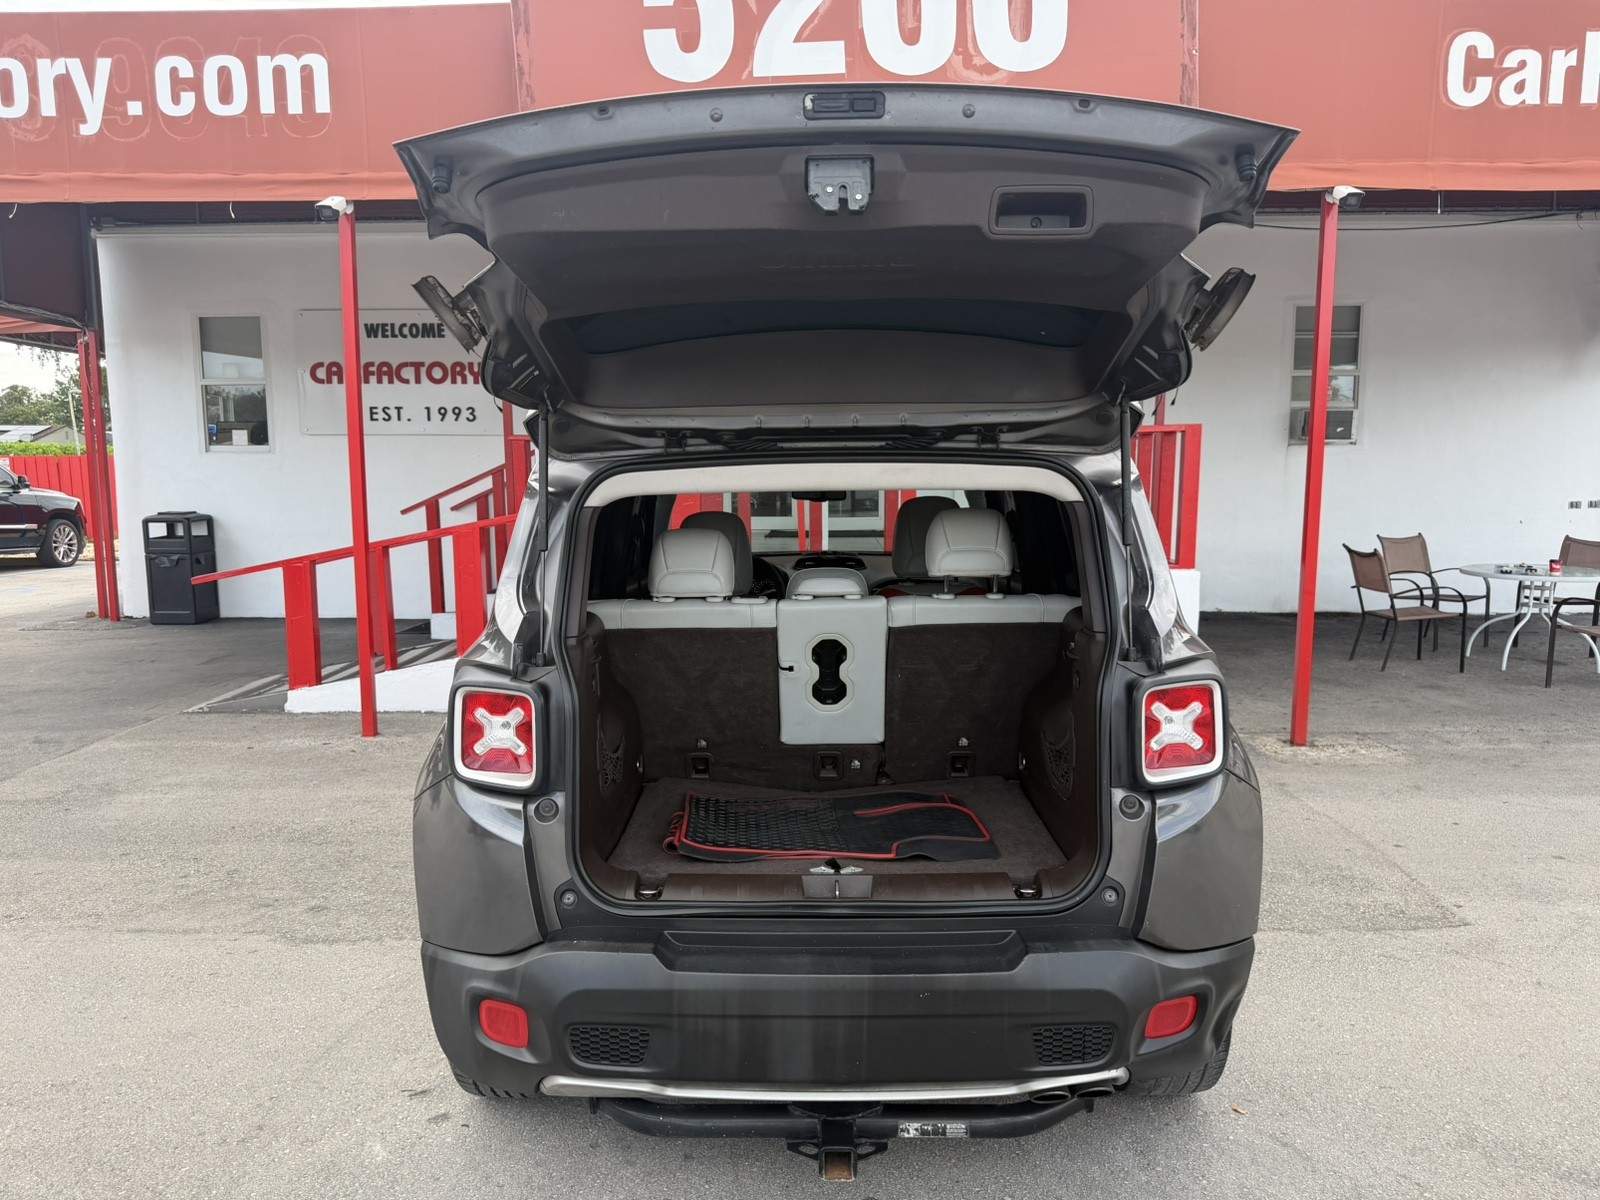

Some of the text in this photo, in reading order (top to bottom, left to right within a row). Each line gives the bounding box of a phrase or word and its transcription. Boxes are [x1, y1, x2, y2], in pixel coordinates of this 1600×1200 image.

[363, 322, 446, 339] WELCOME
[369, 406, 478, 422] EST. 1993
